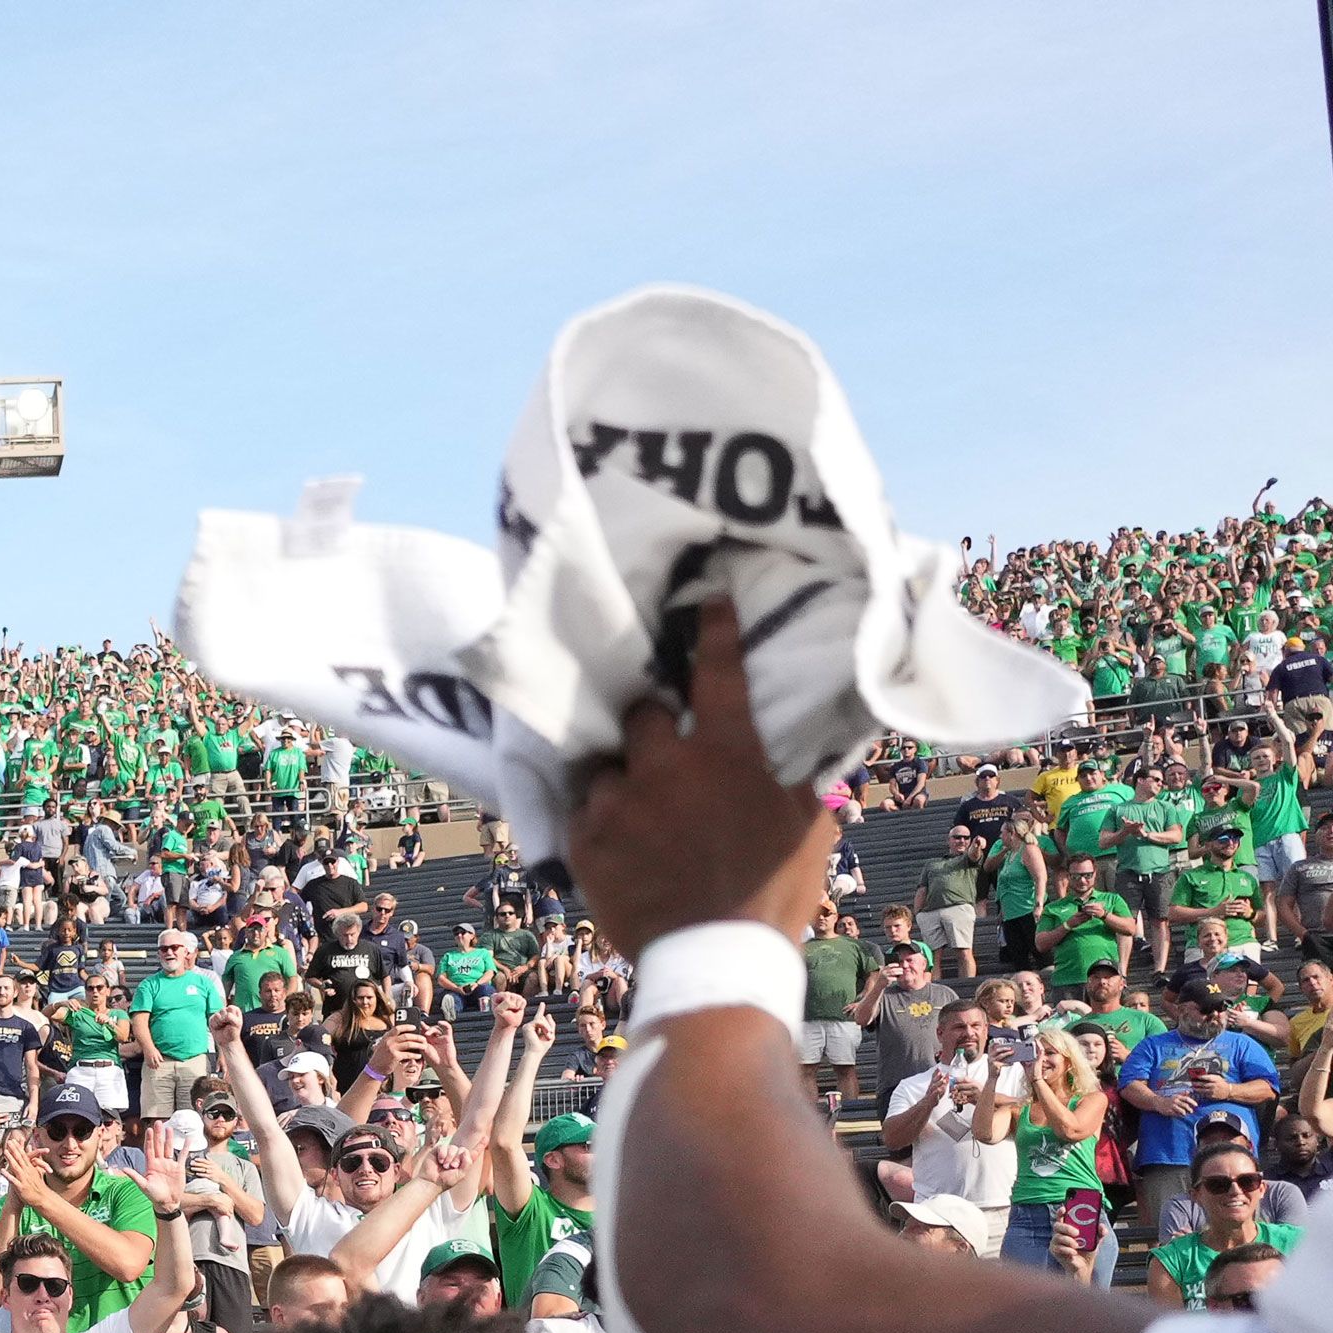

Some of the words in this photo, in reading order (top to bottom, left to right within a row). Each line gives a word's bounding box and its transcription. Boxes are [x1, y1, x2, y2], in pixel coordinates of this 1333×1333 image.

[970, 811, 1008, 821] FOOTBALL
[331, 958, 370, 968] COMISKEY
[1206, 984, 1222, 994] M
[1068, 1203, 1099, 1227] C
